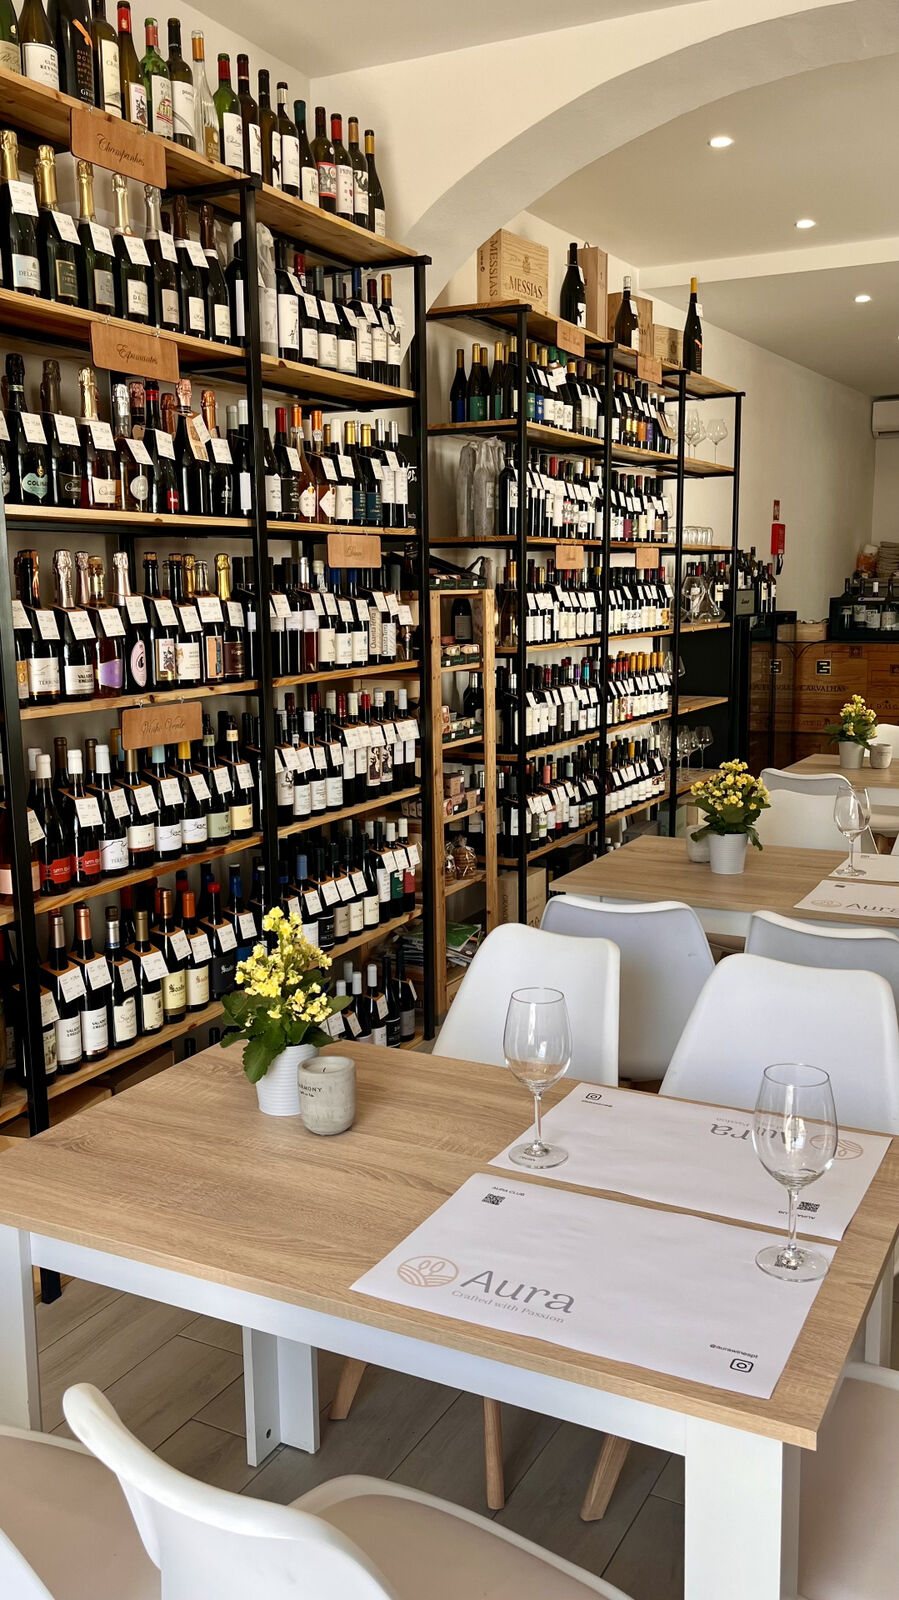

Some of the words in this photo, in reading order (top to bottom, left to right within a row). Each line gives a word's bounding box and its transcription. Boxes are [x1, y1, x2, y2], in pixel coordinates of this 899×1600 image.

[489, 240, 498, 297] MESSIAS
[509, 275, 543, 299] MESSIAS
[799, 684, 848, 693] CARVALHAS
[451, 1290, 493, 1305] Crafted
[494, 1302, 519, 1312] with
[521, 1307, 565, 1324] Passion
[460, 1270, 575, 1313] Aura
